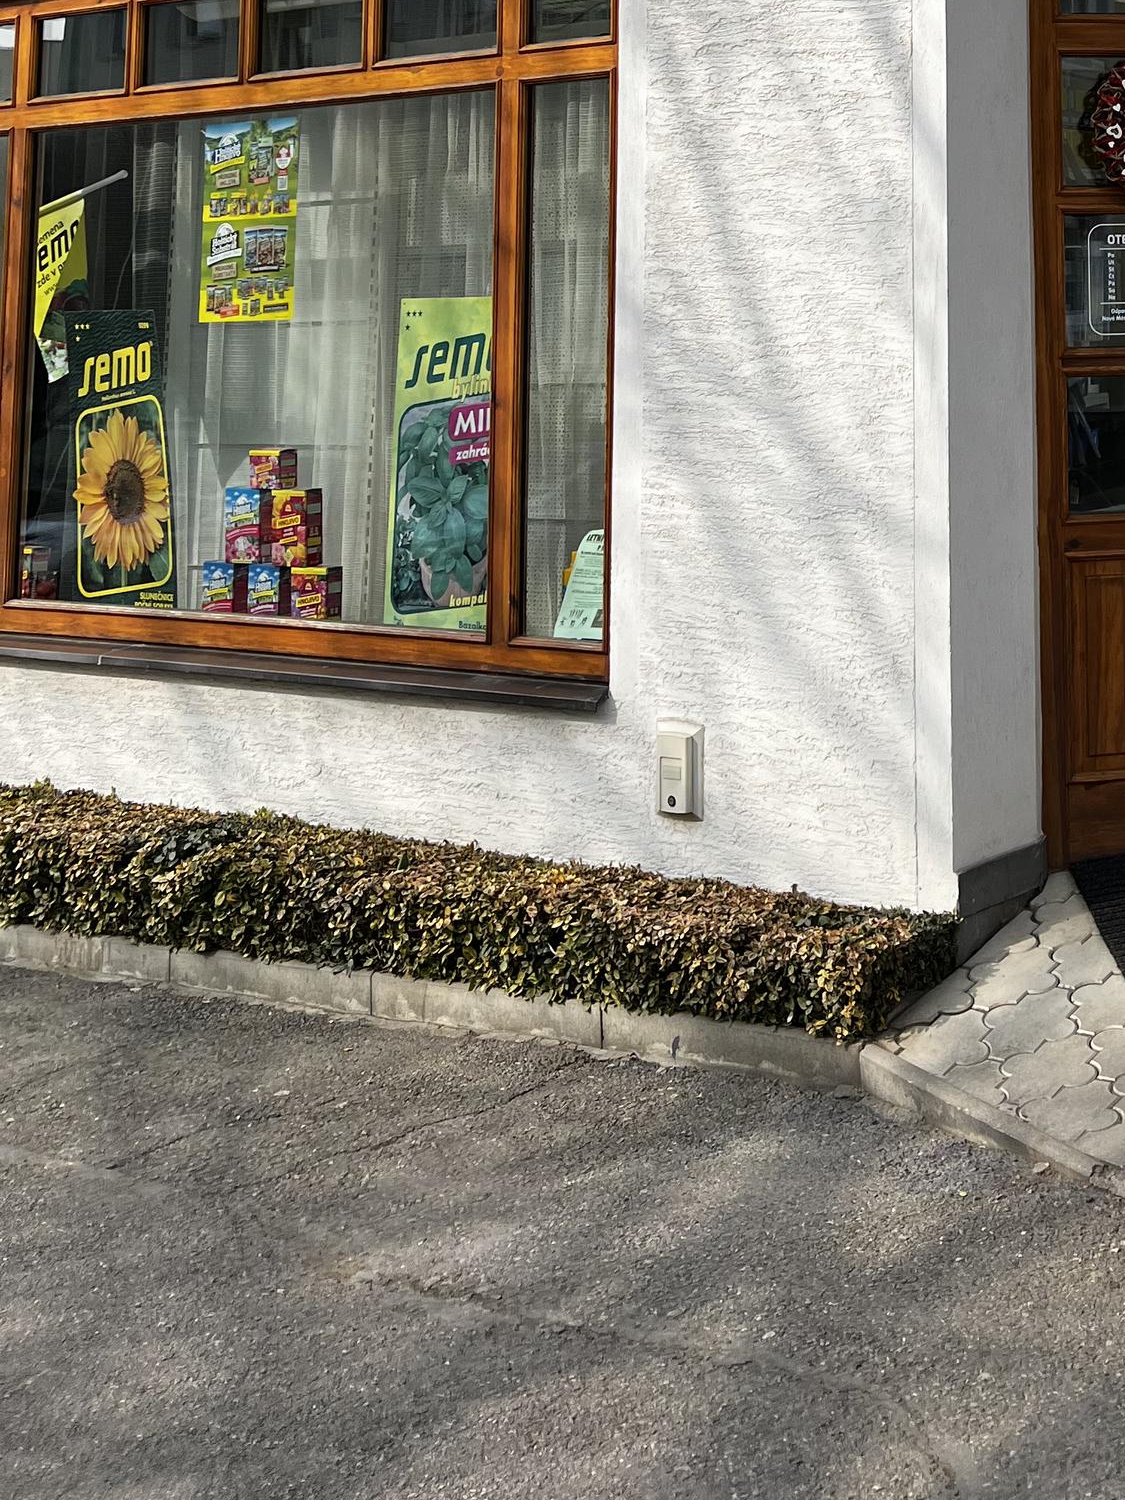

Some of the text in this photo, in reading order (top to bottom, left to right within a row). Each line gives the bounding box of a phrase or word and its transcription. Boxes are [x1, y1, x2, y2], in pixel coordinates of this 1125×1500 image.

[78, 341, 152, 397] semo
[404, 332, 491, 389] sem
[452, 374, 491, 403] bylin
[456, 442, 490, 461] zahrá
